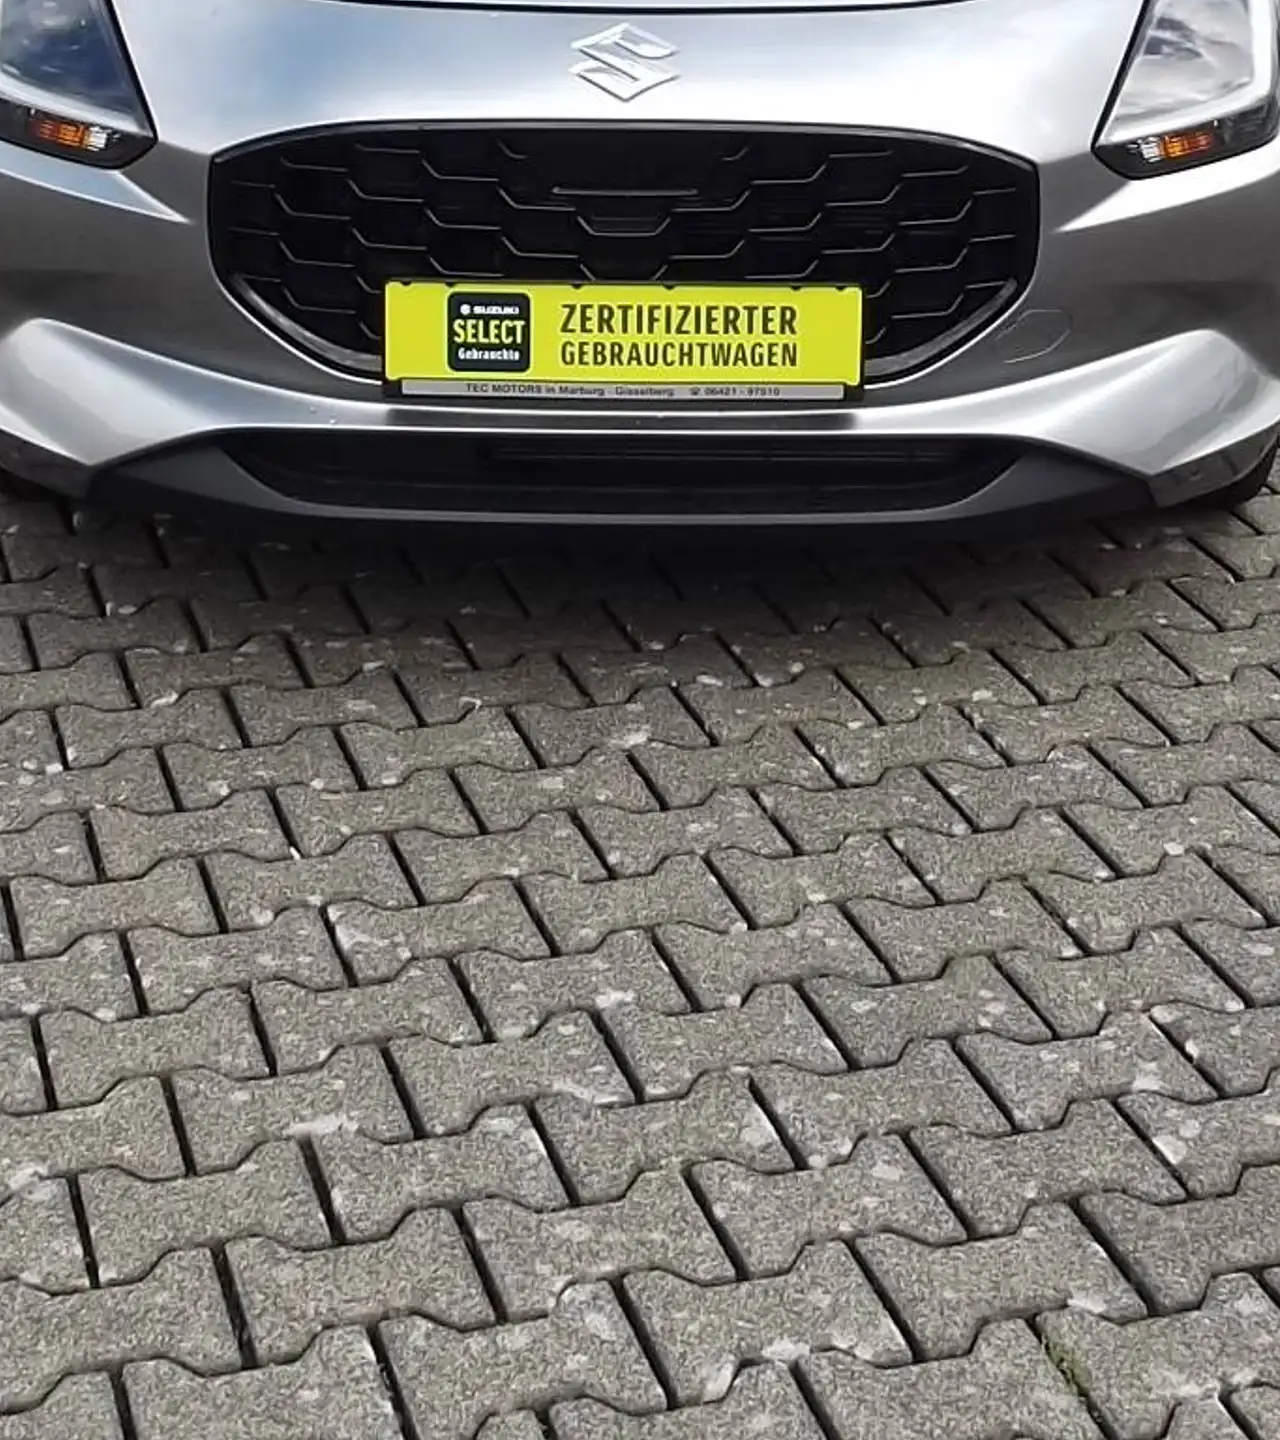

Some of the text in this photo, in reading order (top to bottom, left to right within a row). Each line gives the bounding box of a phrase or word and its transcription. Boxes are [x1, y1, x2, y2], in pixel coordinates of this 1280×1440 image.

[453, 319, 526, 344] SELECT
[560, 304, 798, 335] ZERTIFIZIERTER
[458, 347, 520, 361] Gebrauchte
[560, 340, 798, 368] GEBRAUCHTWAGEN
[466, 383, 489, 393] TEC
[491, 383, 542, 395] MOTORS
[545, 385, 556, 394] in
[559, 385, 605, 397] Marburg
